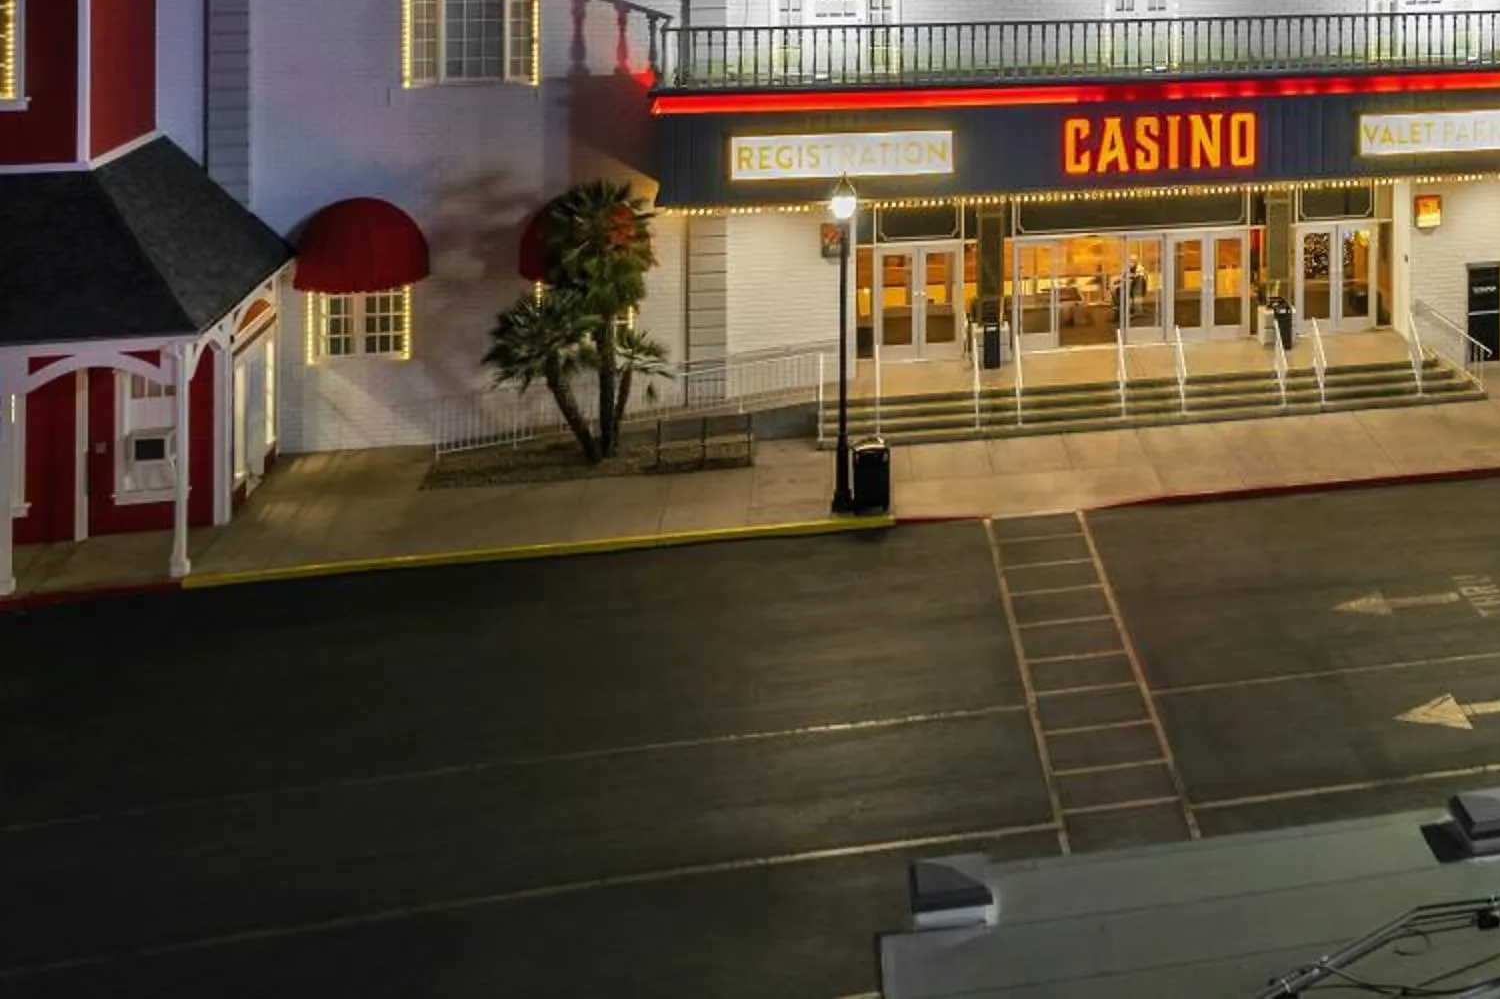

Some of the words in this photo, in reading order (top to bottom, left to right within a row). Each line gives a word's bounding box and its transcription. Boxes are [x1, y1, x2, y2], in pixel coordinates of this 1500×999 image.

[1064, 111, 1256, 174] CASINO
[1363, 121, 1435, 147] VALET
[736, 139, 948, 170] REGISTRATION
